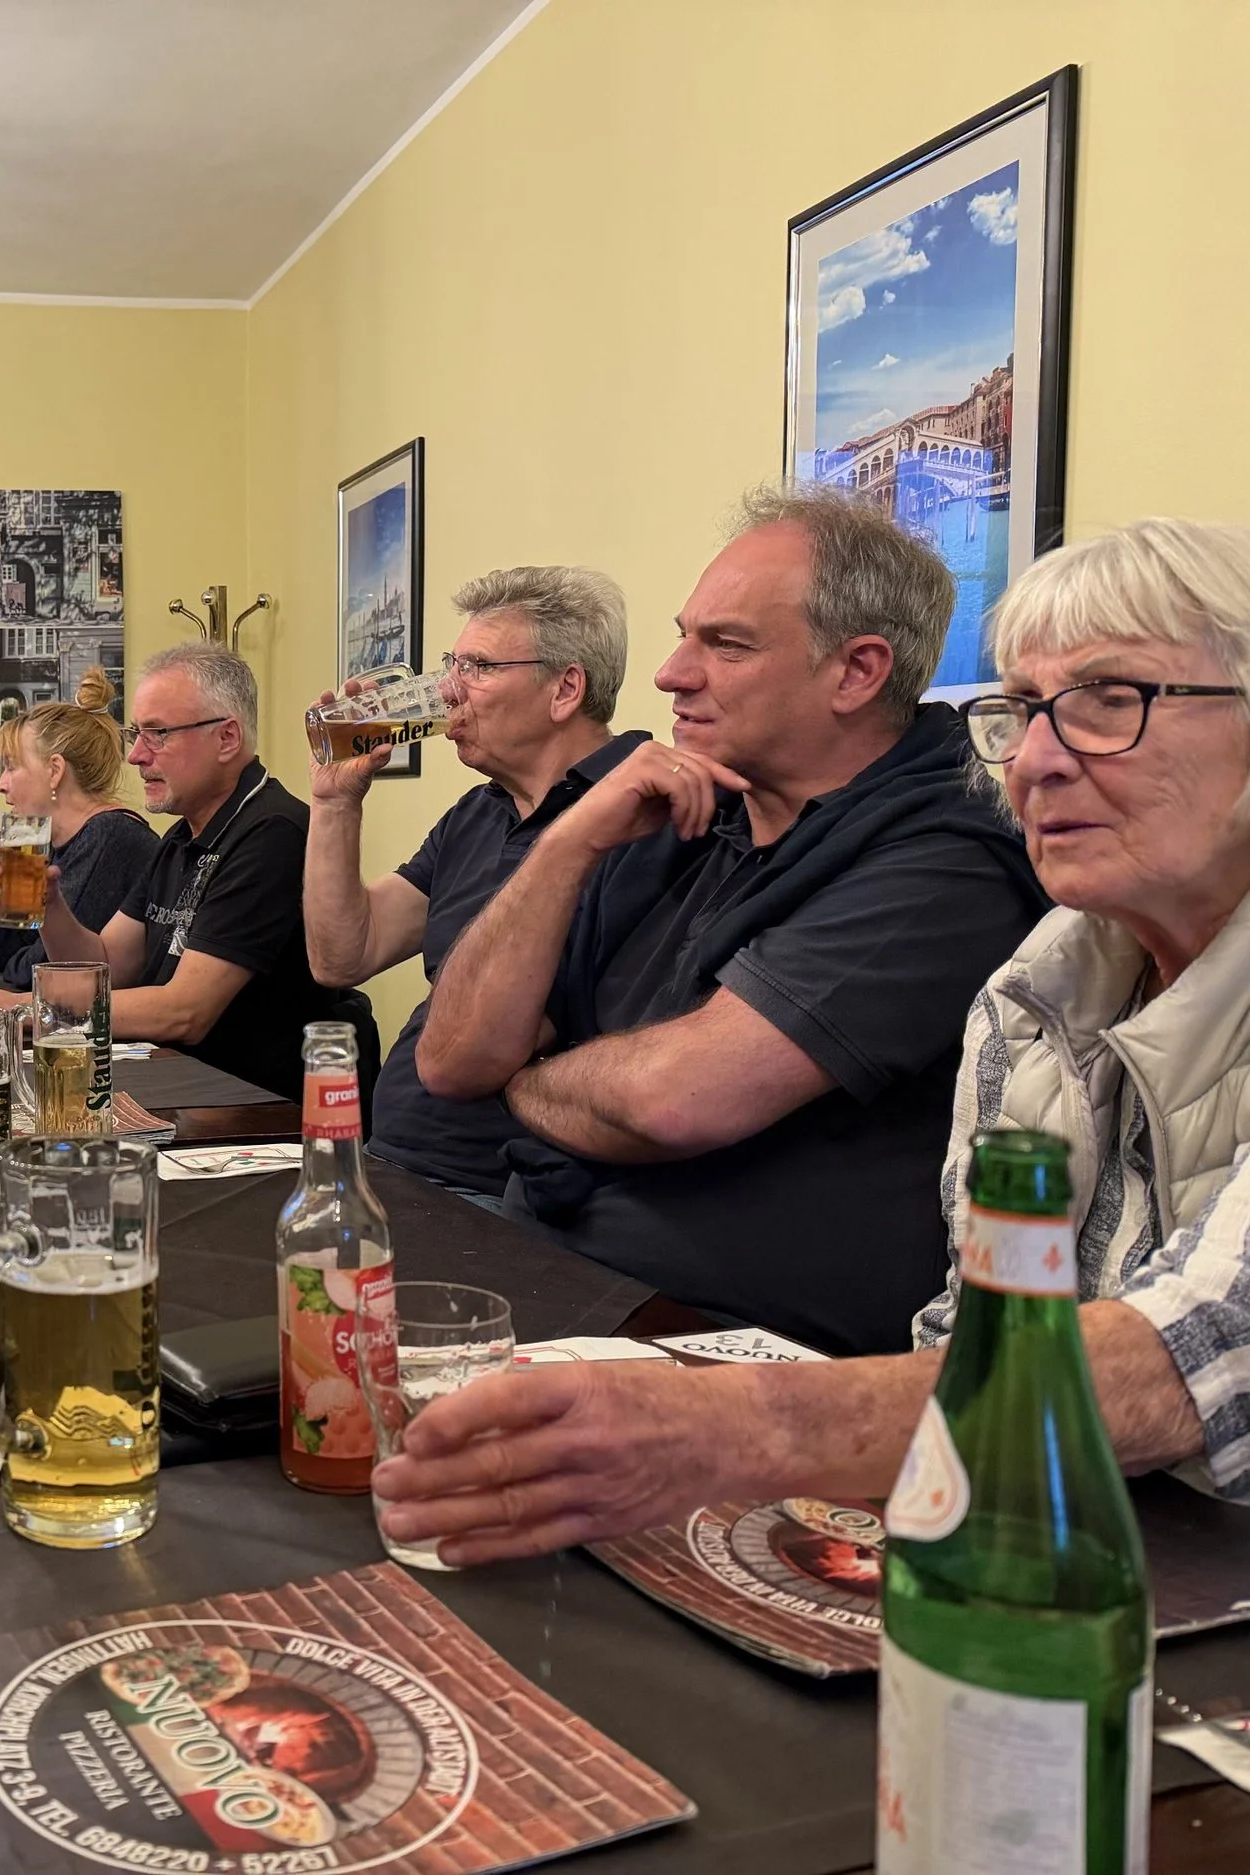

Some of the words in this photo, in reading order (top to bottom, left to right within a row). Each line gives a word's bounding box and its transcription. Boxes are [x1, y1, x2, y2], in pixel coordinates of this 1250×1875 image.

[682, 1342, 800, 1363] NUOVO
[715, 1333, 773, 1350] 13
[822, 1606, 881, 1629] OLCE
[286, 1637, 360, 1671] DOLCE
[352, 1655, 405, 1692] VITA
[392, 1682, 427, 1706] IN
[407, 1696, 454, 1729] DER
[84, 1709, 183, 1821] RISTORANTE
[128, 1673, 284, 1829] NUOVO
[57, 1730, 130, 1812] PIZZERIA
[30, 1798, 80, 1837] TEL.
[75, 1826, 210, 1873] 6848220
[241, 1846, 340, 1875] 52267
